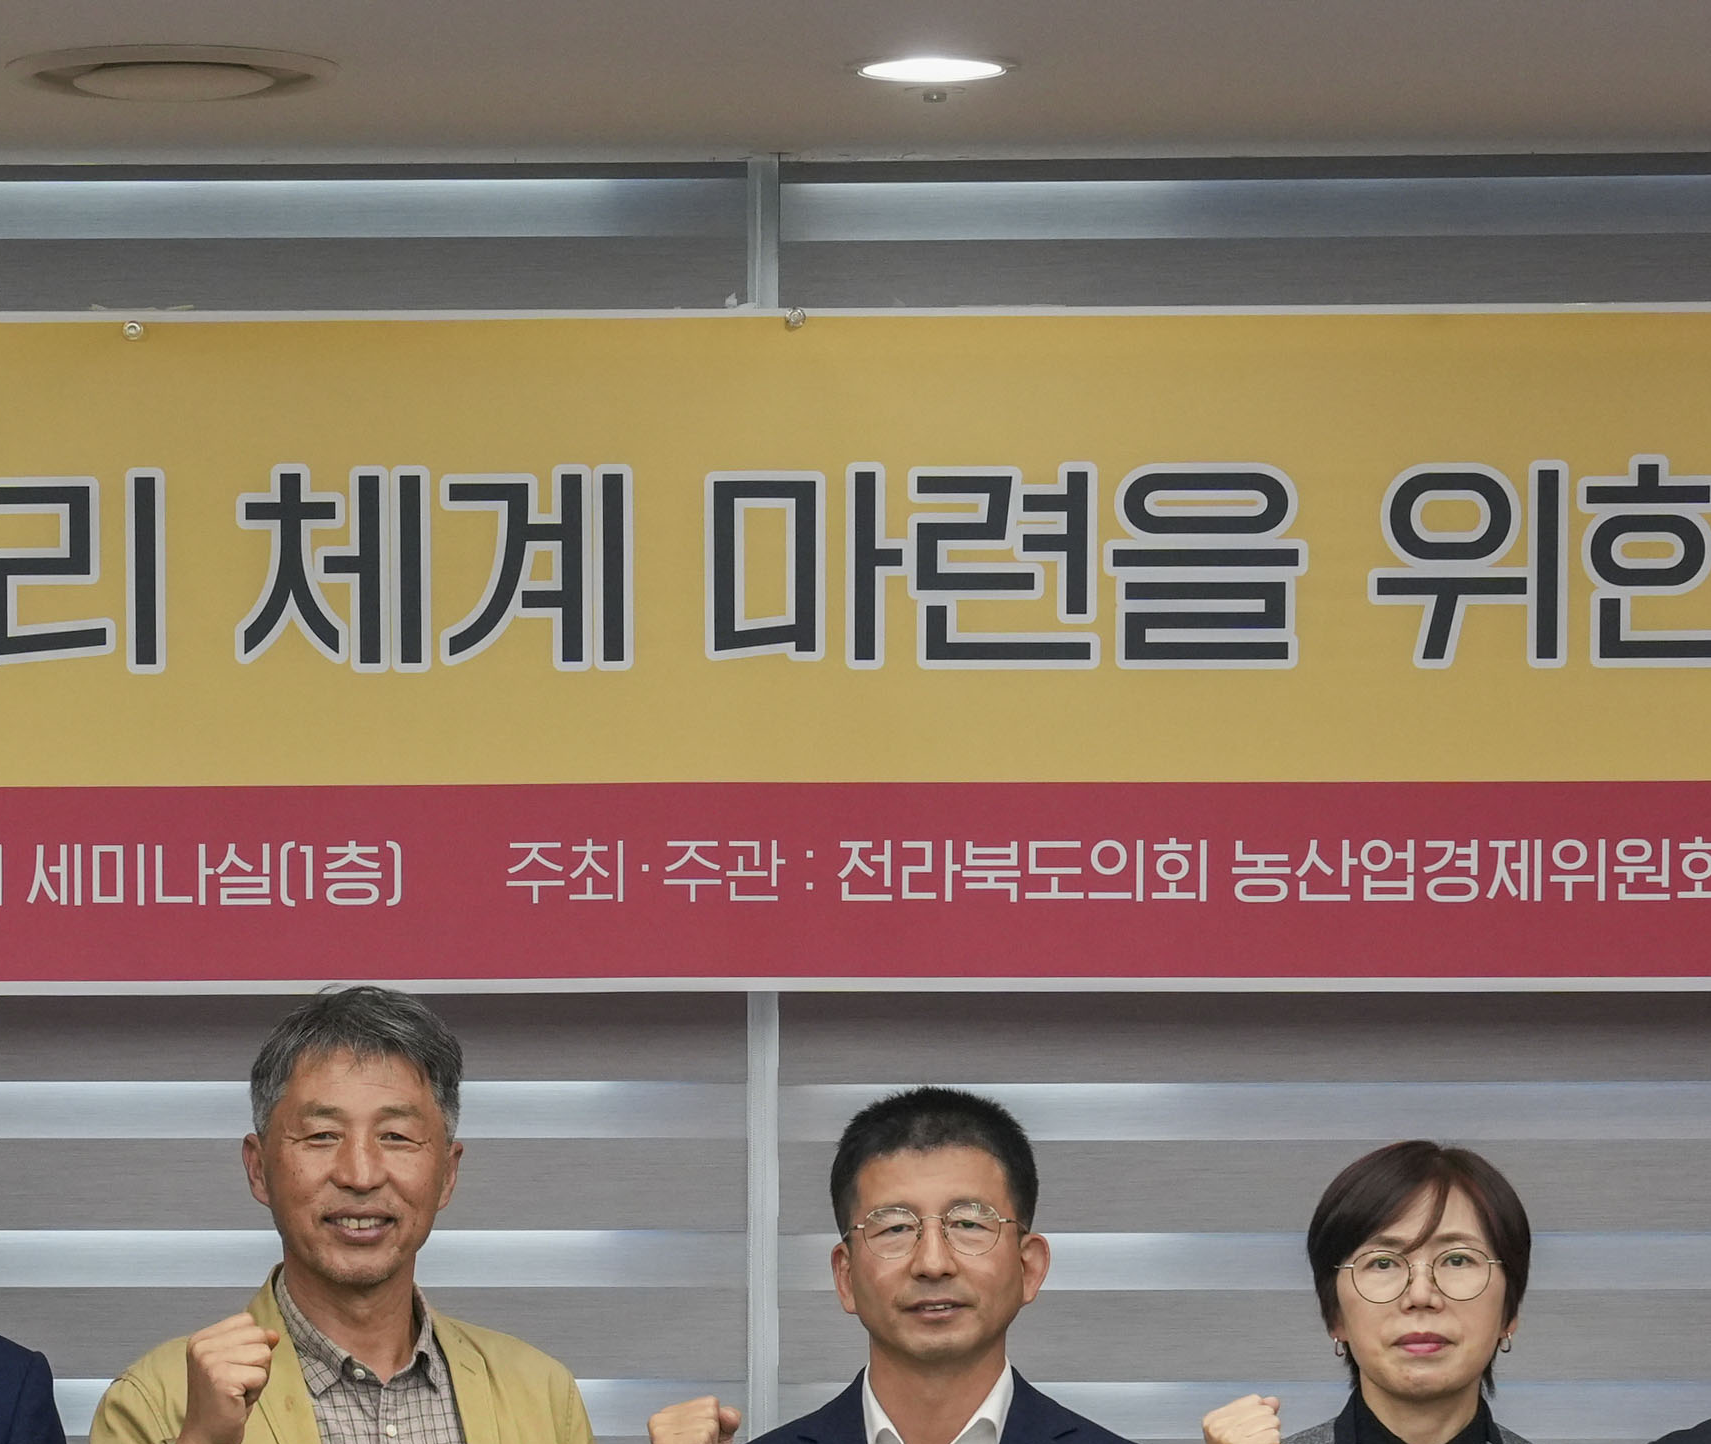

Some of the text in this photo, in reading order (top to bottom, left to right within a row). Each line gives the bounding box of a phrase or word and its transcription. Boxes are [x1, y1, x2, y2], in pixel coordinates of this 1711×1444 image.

[243, 471, 626, 665] 체계
[712, 470, 1300, 662] 마련을
[25, 839, 403, 908] 세미나실(1층)
[836, 836, 1209, 904] 전라북도의회
